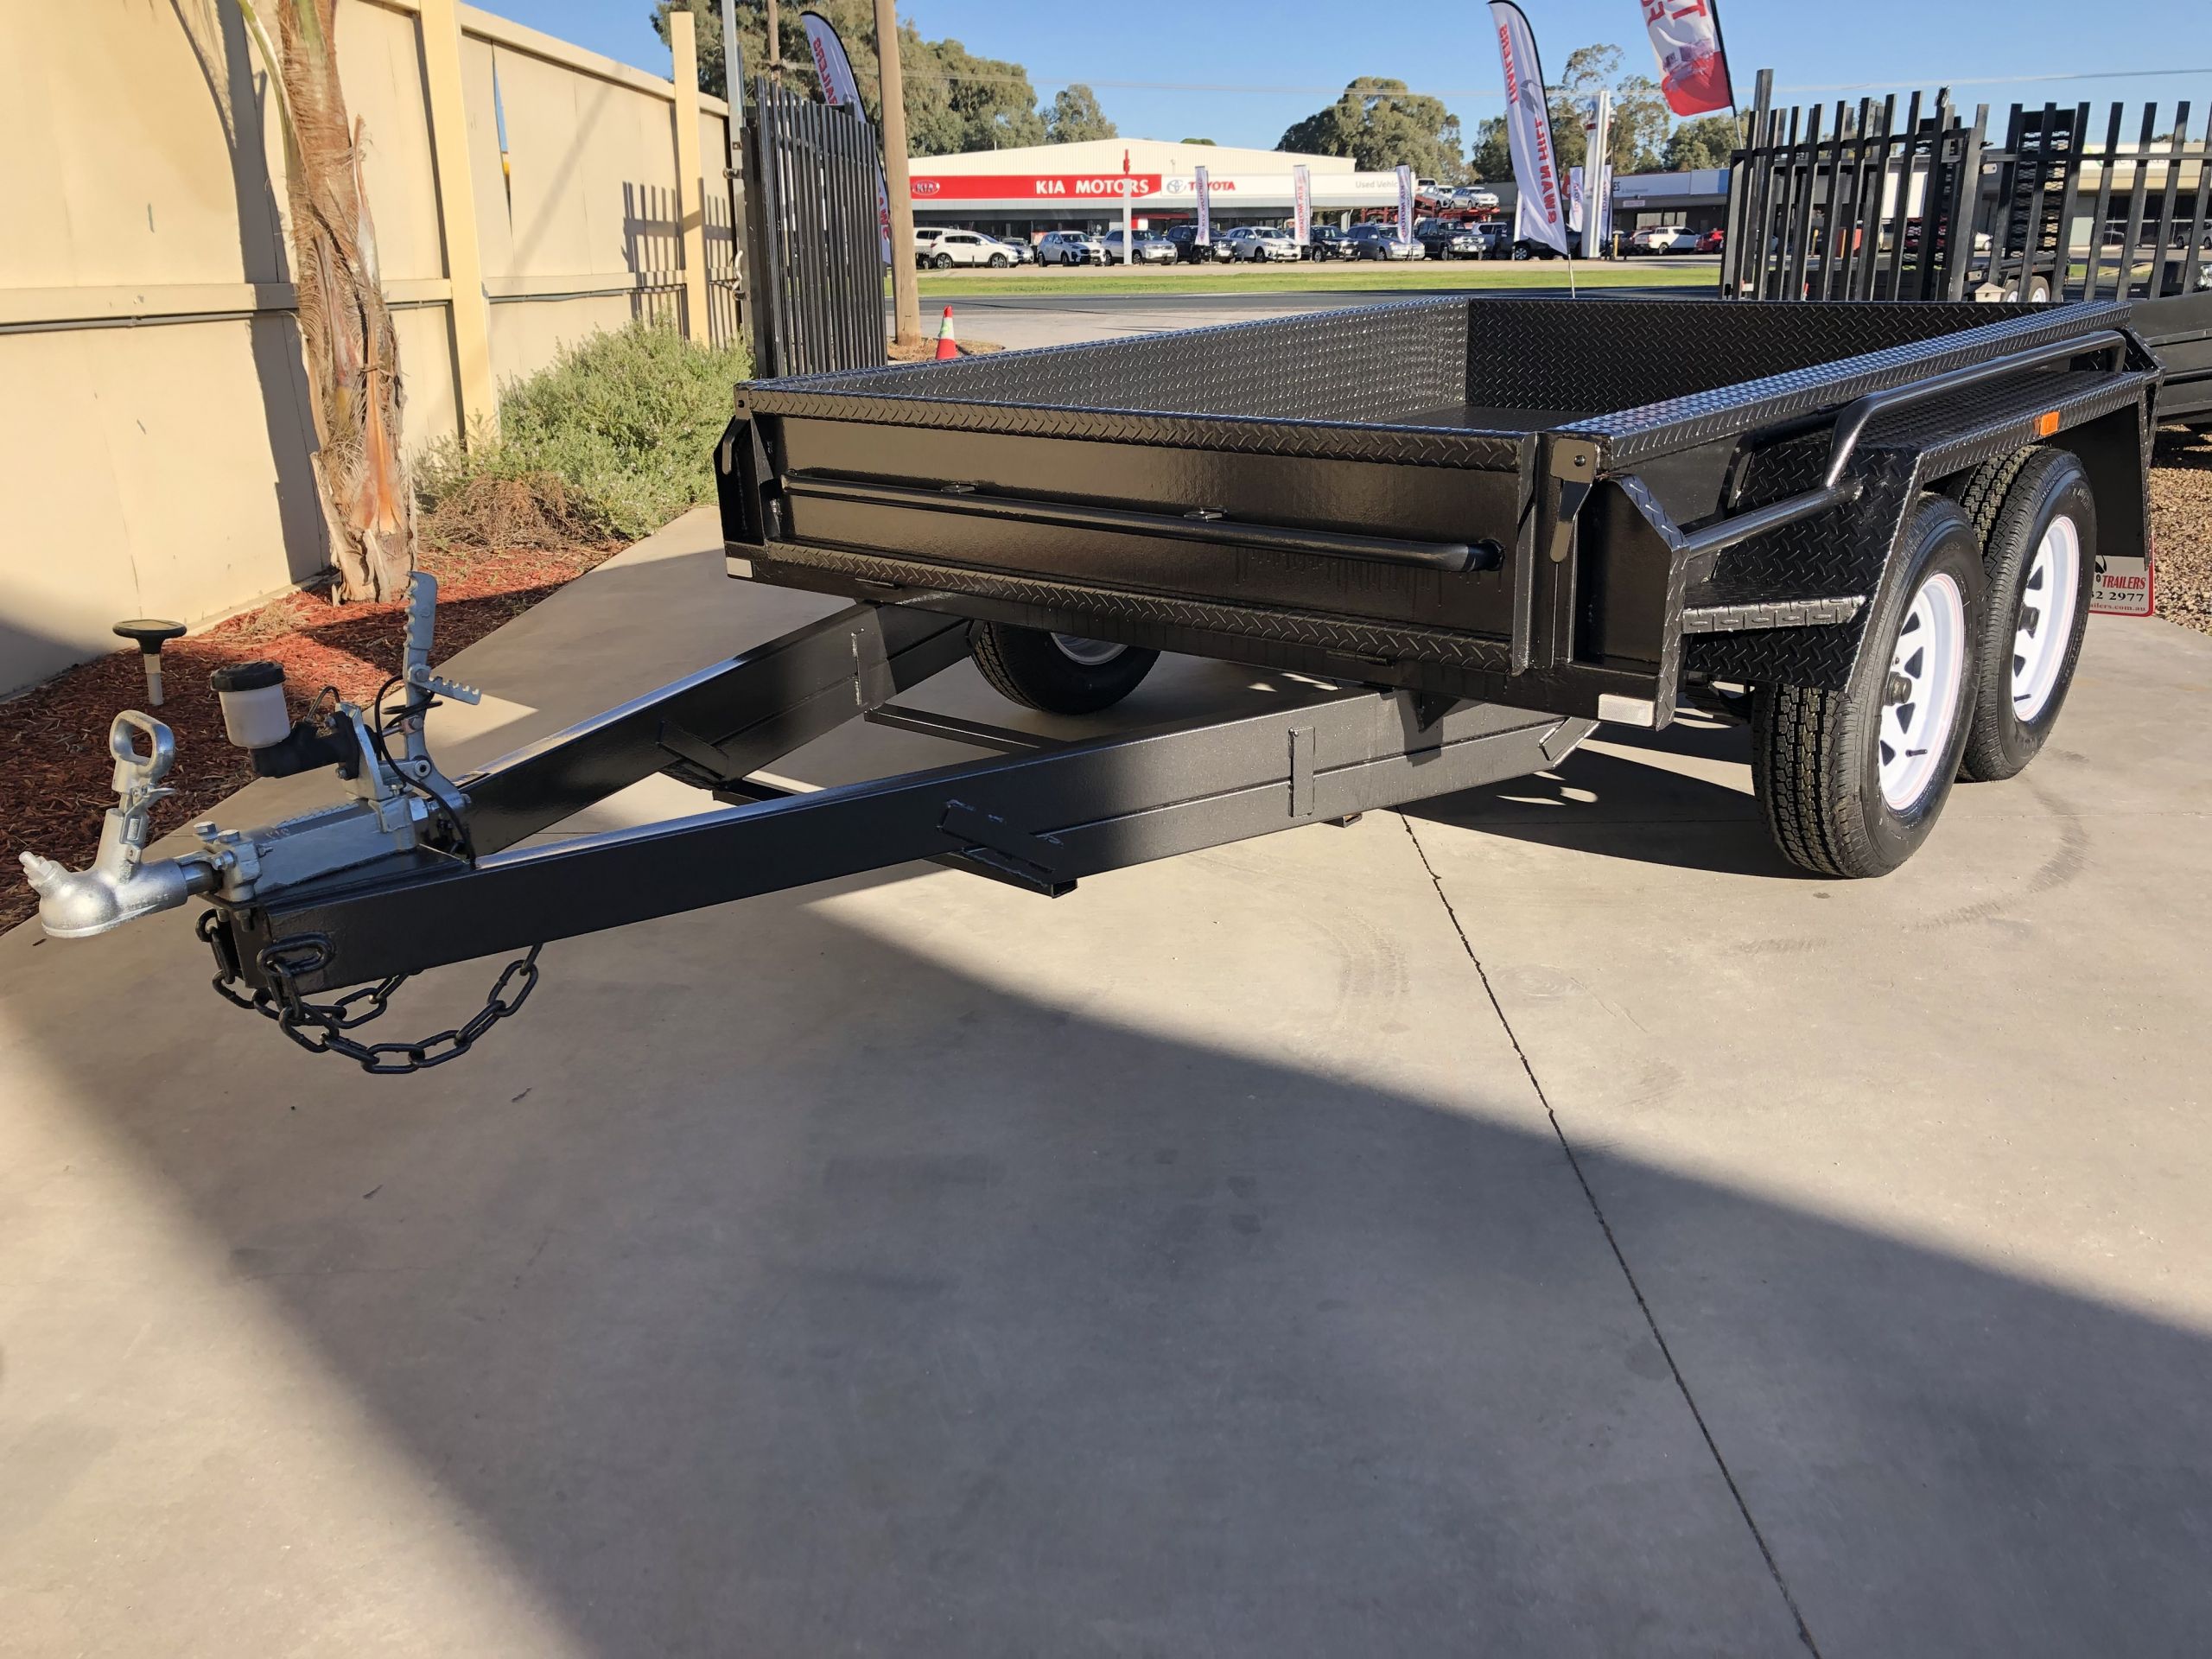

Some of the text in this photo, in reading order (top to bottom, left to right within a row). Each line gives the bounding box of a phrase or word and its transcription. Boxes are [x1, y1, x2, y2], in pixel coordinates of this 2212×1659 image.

[1035, 179, 1149, 194] KIA MOTORS
[1188, 181, 1236, 192] TYOTA
[1356, 180, 1376, 188] Used
[2102, 575, 2146, 590] TRAILERS
[2109, 591, 2145, 602] 2977
